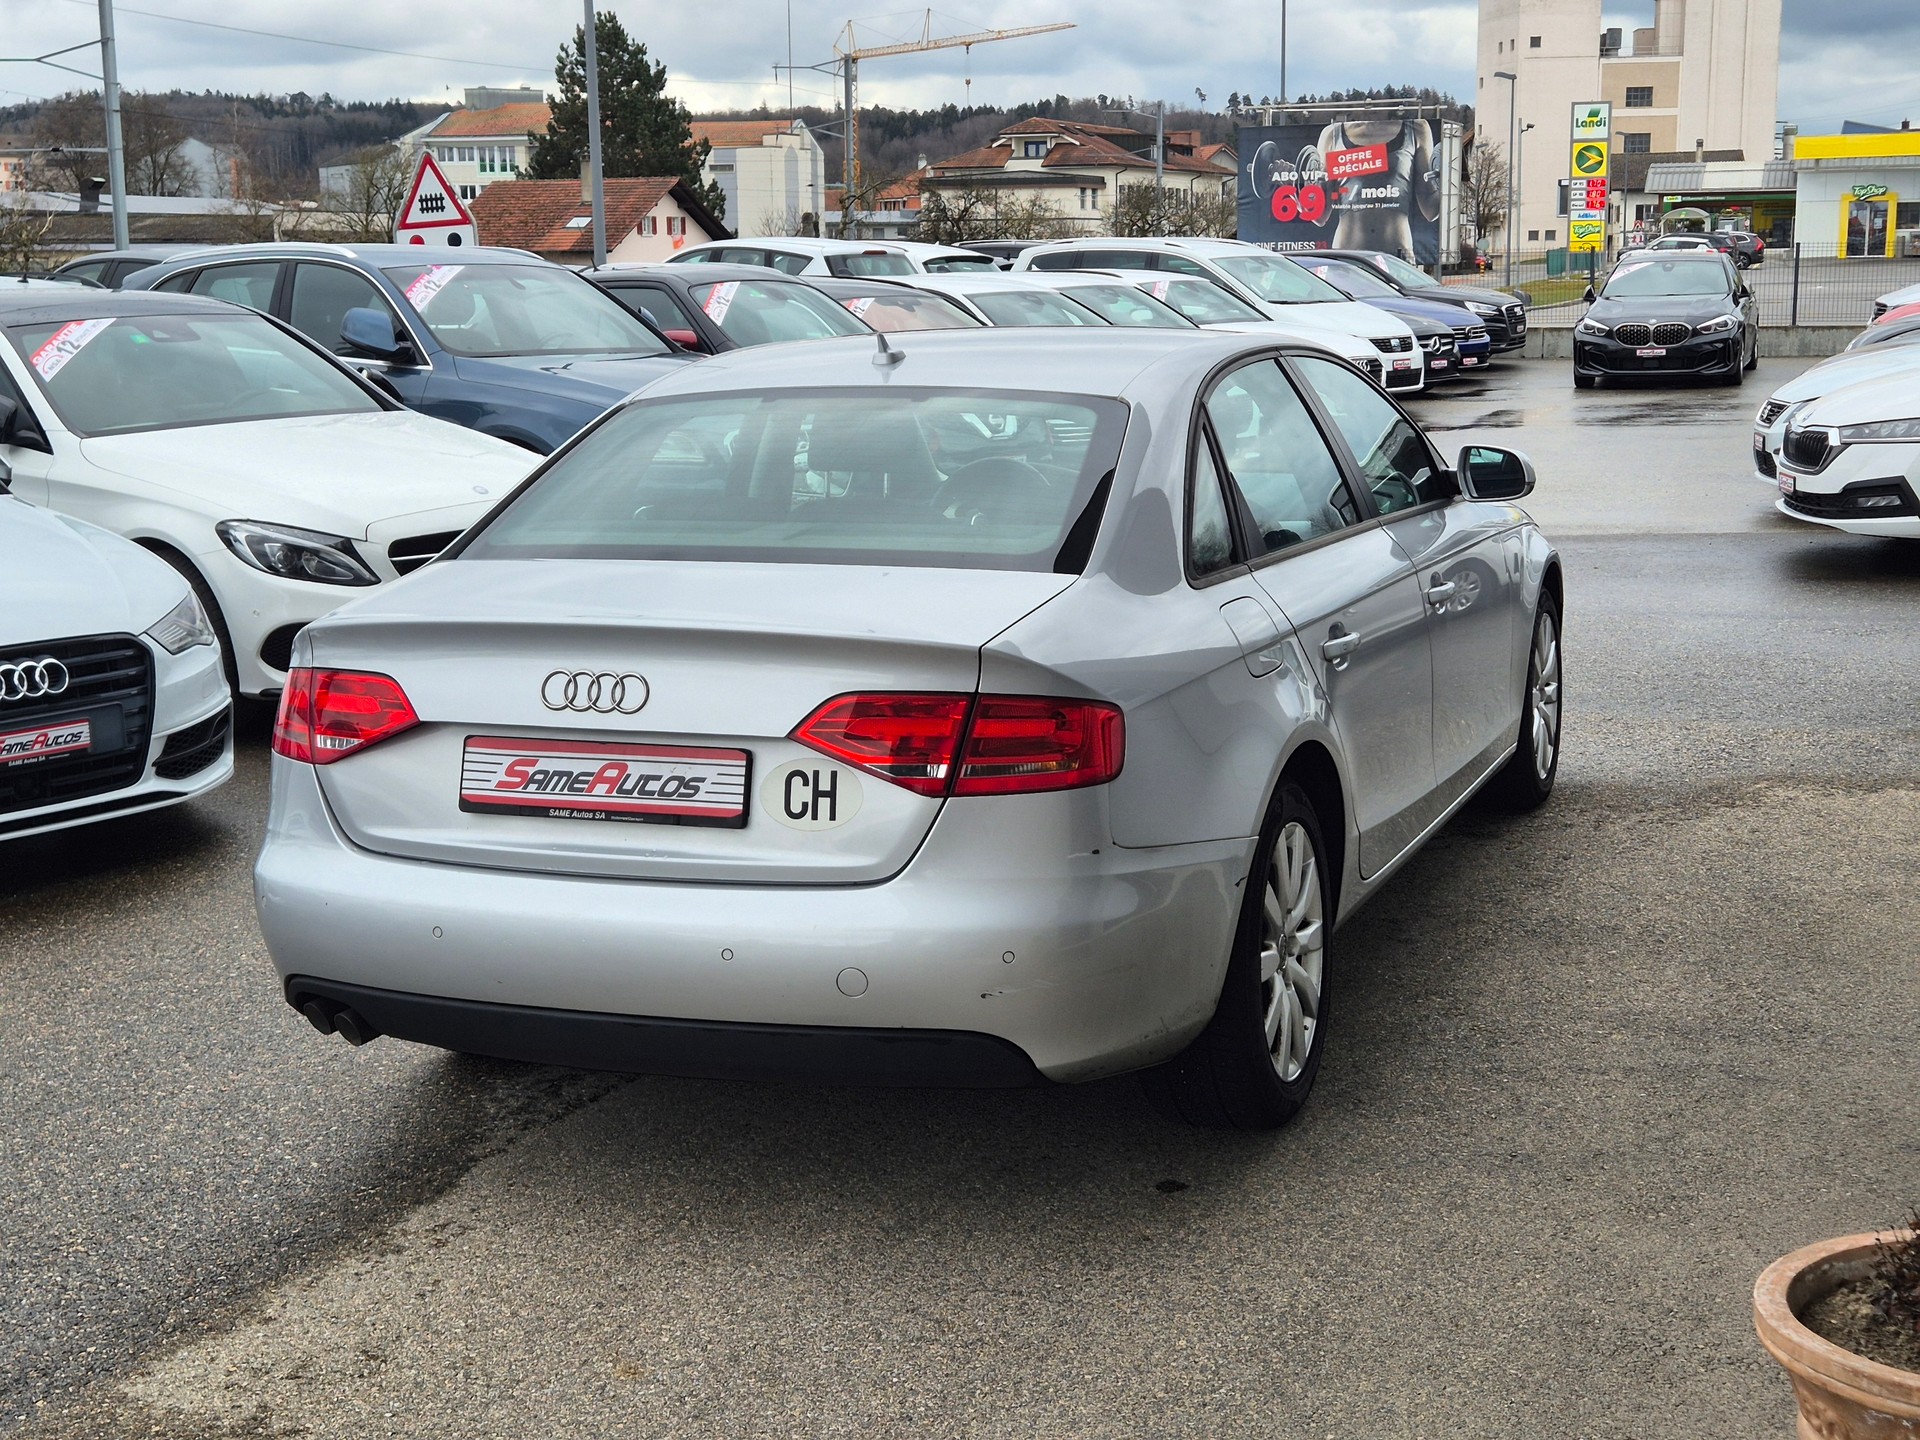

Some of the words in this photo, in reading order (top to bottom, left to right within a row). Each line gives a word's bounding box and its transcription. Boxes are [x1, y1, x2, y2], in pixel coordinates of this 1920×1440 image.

[1575, 117, 1607, 129] Landi
[1337, 150, 1372, 163] OFFRE
[1332, 159, 1383, 175] SPÉCIALE
[1272, 171, 1299, 182] ABO
[1301, 170, 1322, 182] VIP
[1361, 185, 1400, 199] mois
[1277, 241, 1316, 251] FITNESS
[56, 340, 82, 355] 12
[784, 769, 836, 822] CH
[548, 808, 572, 818] SAME
[571, 810, 594, 819] Autos
[594, 811, 606, 819] SA
